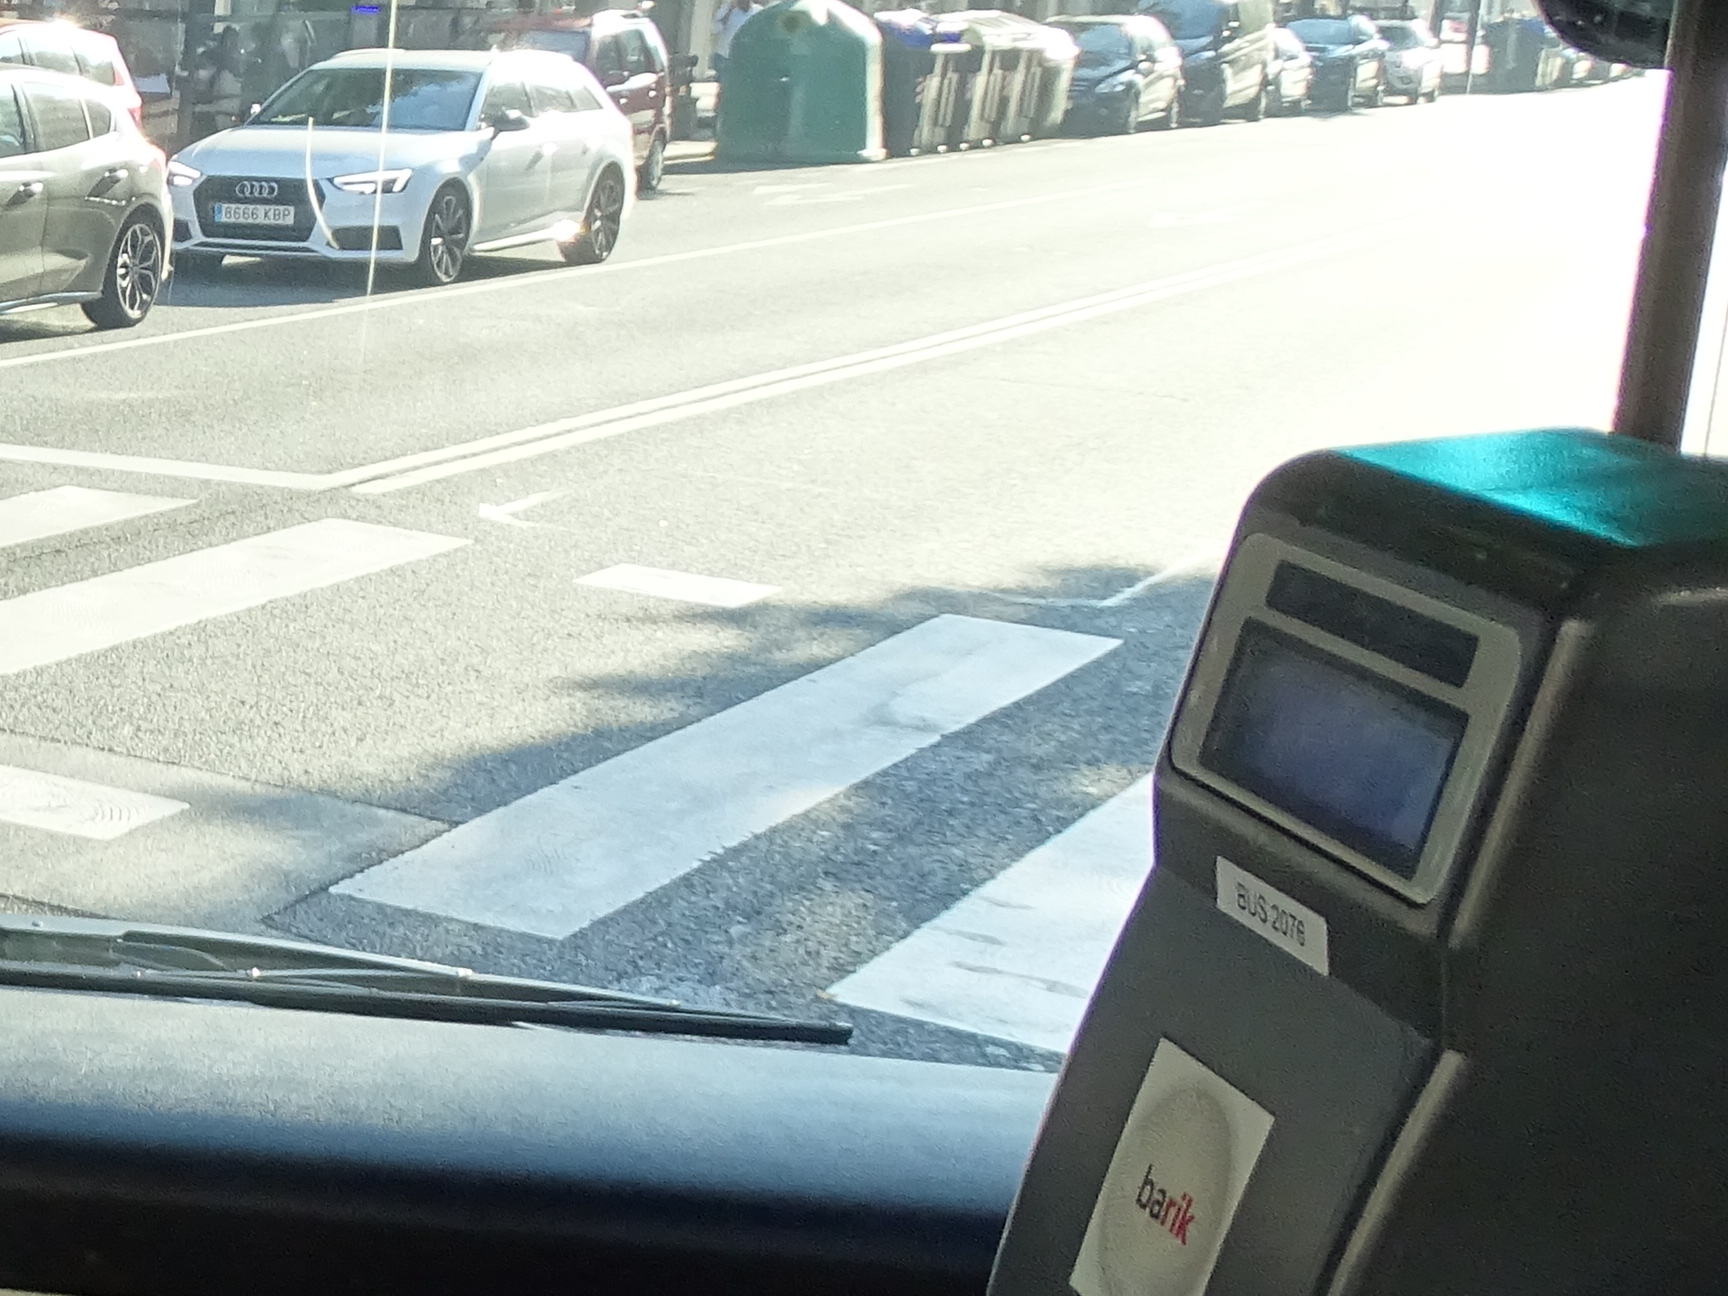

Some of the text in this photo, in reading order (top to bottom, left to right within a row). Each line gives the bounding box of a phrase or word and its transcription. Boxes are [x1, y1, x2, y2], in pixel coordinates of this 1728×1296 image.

[263, 207, 291, 221] KBP
[1236, 880, 1306, 947] BUS 2076
[1135, 1163, 1196, 1246] barik
